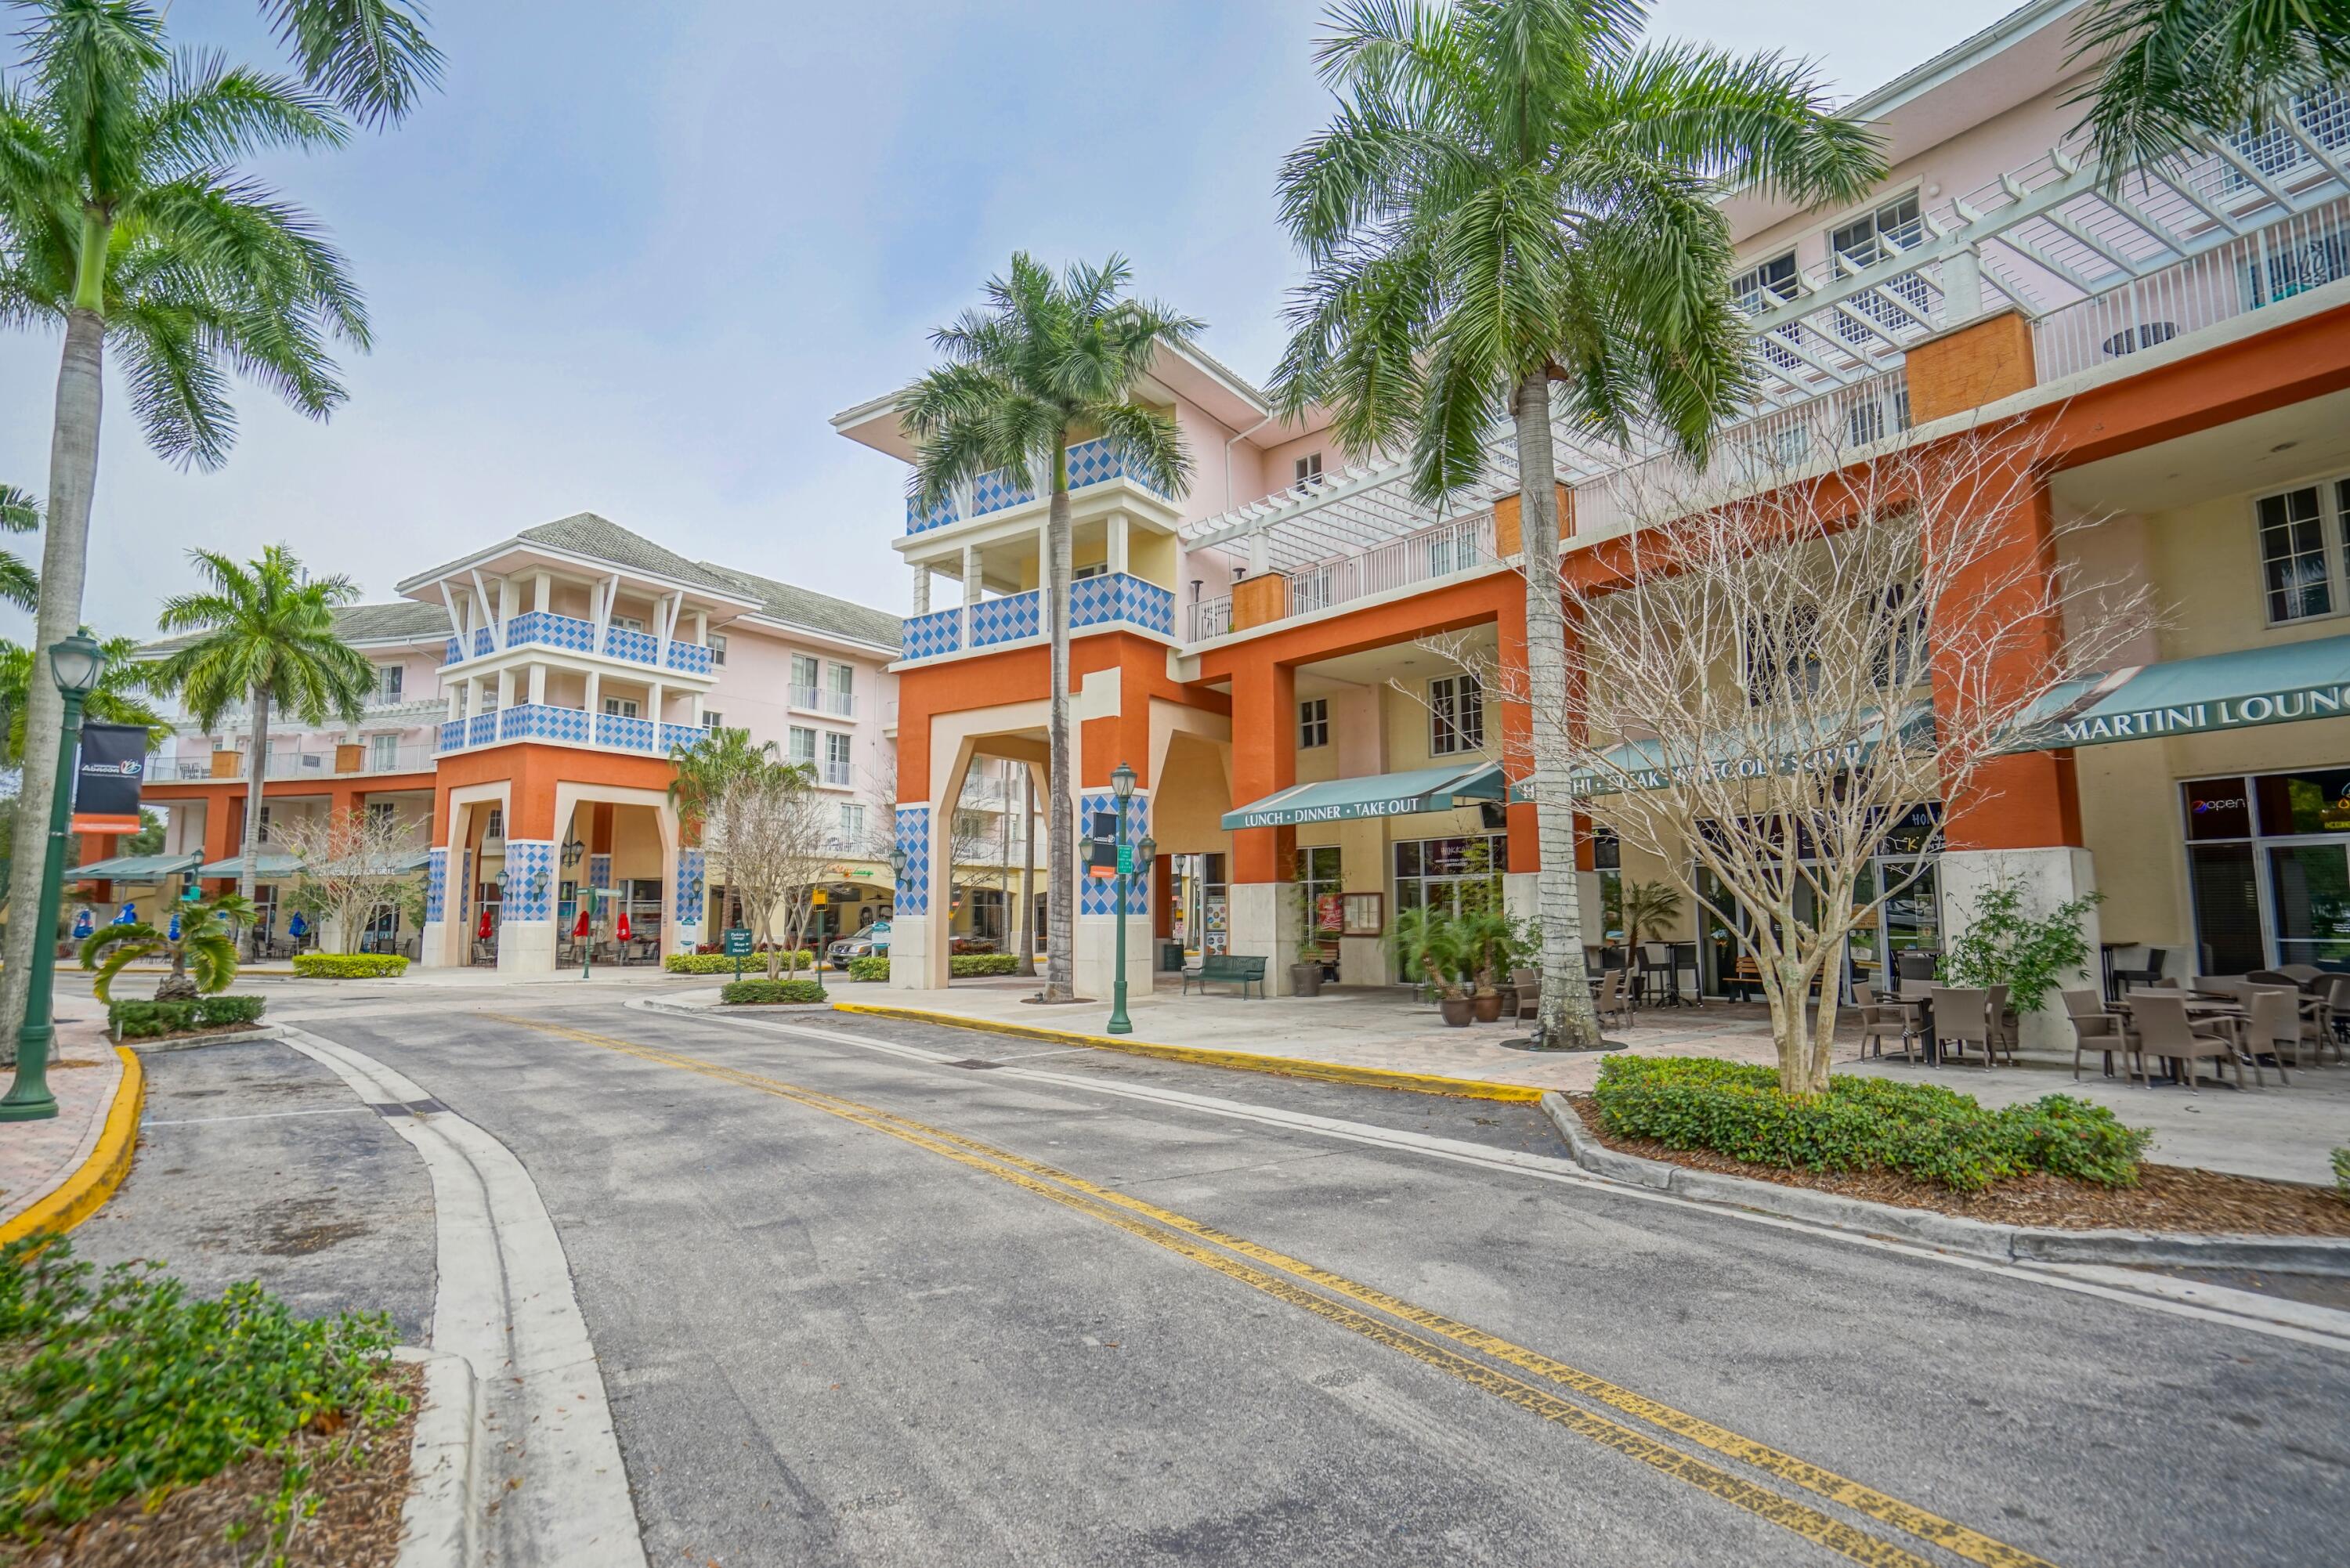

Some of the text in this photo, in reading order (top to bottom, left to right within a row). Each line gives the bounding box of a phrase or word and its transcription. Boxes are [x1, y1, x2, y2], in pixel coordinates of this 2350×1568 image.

[2063, 704, 2207, 742] MARTINI
[1608, 771, 1661, 791] STEAK
[1676, 758, 1773, 781] SAFOOD
[1245, 797, 1419, 827] LUNCH DINNER TAKE OUT
[2206, 798, 2246, 811] open
